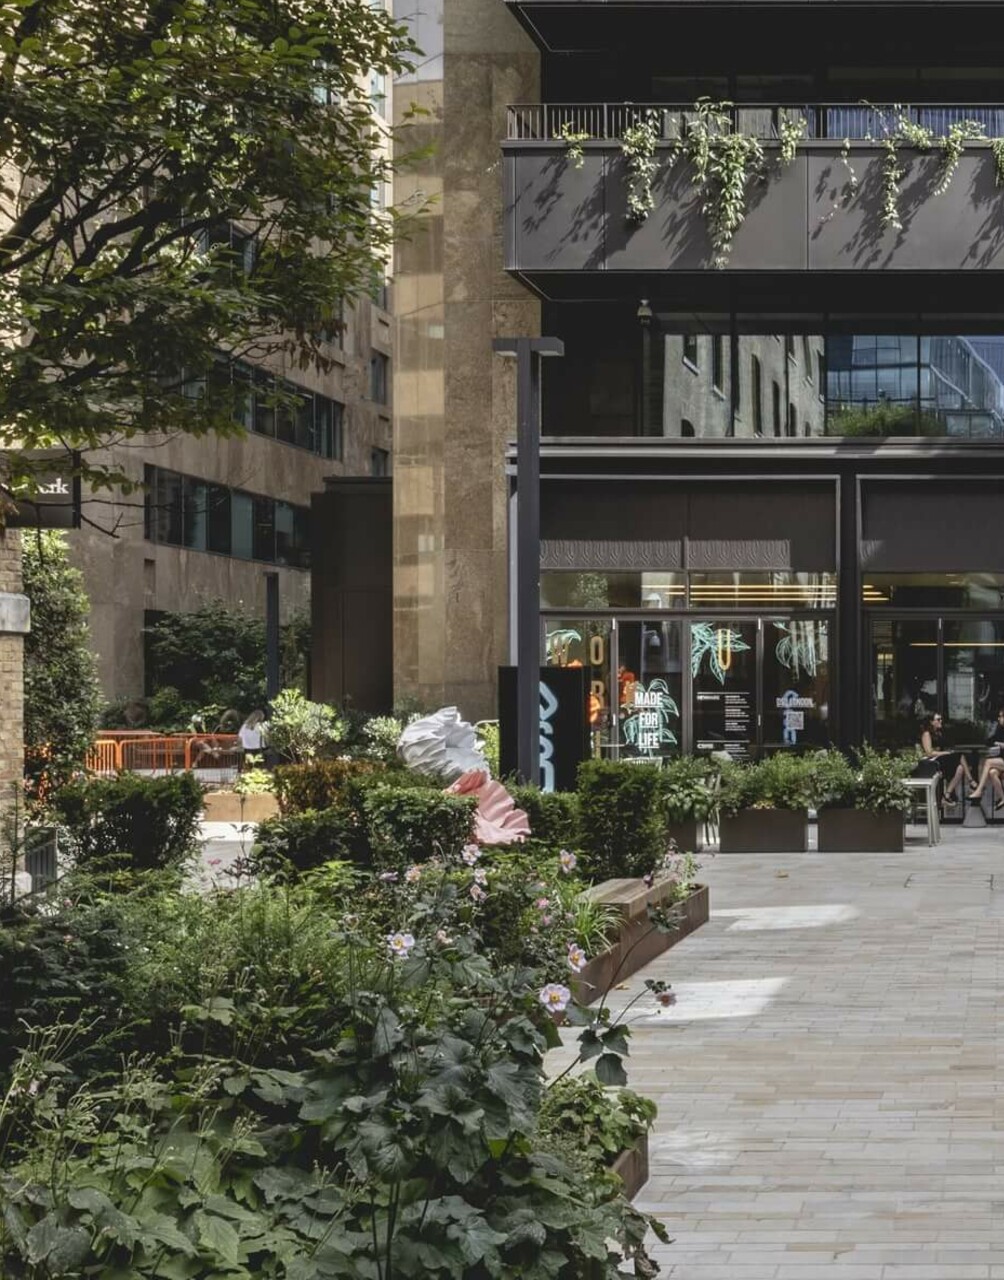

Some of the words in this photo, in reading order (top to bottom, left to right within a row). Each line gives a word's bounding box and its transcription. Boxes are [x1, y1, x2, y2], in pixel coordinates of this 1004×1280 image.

[635, 692, 663, 706] MADE
[640, 712, 659, 725] FOR
[638, 733, 660, 746] LIFE
